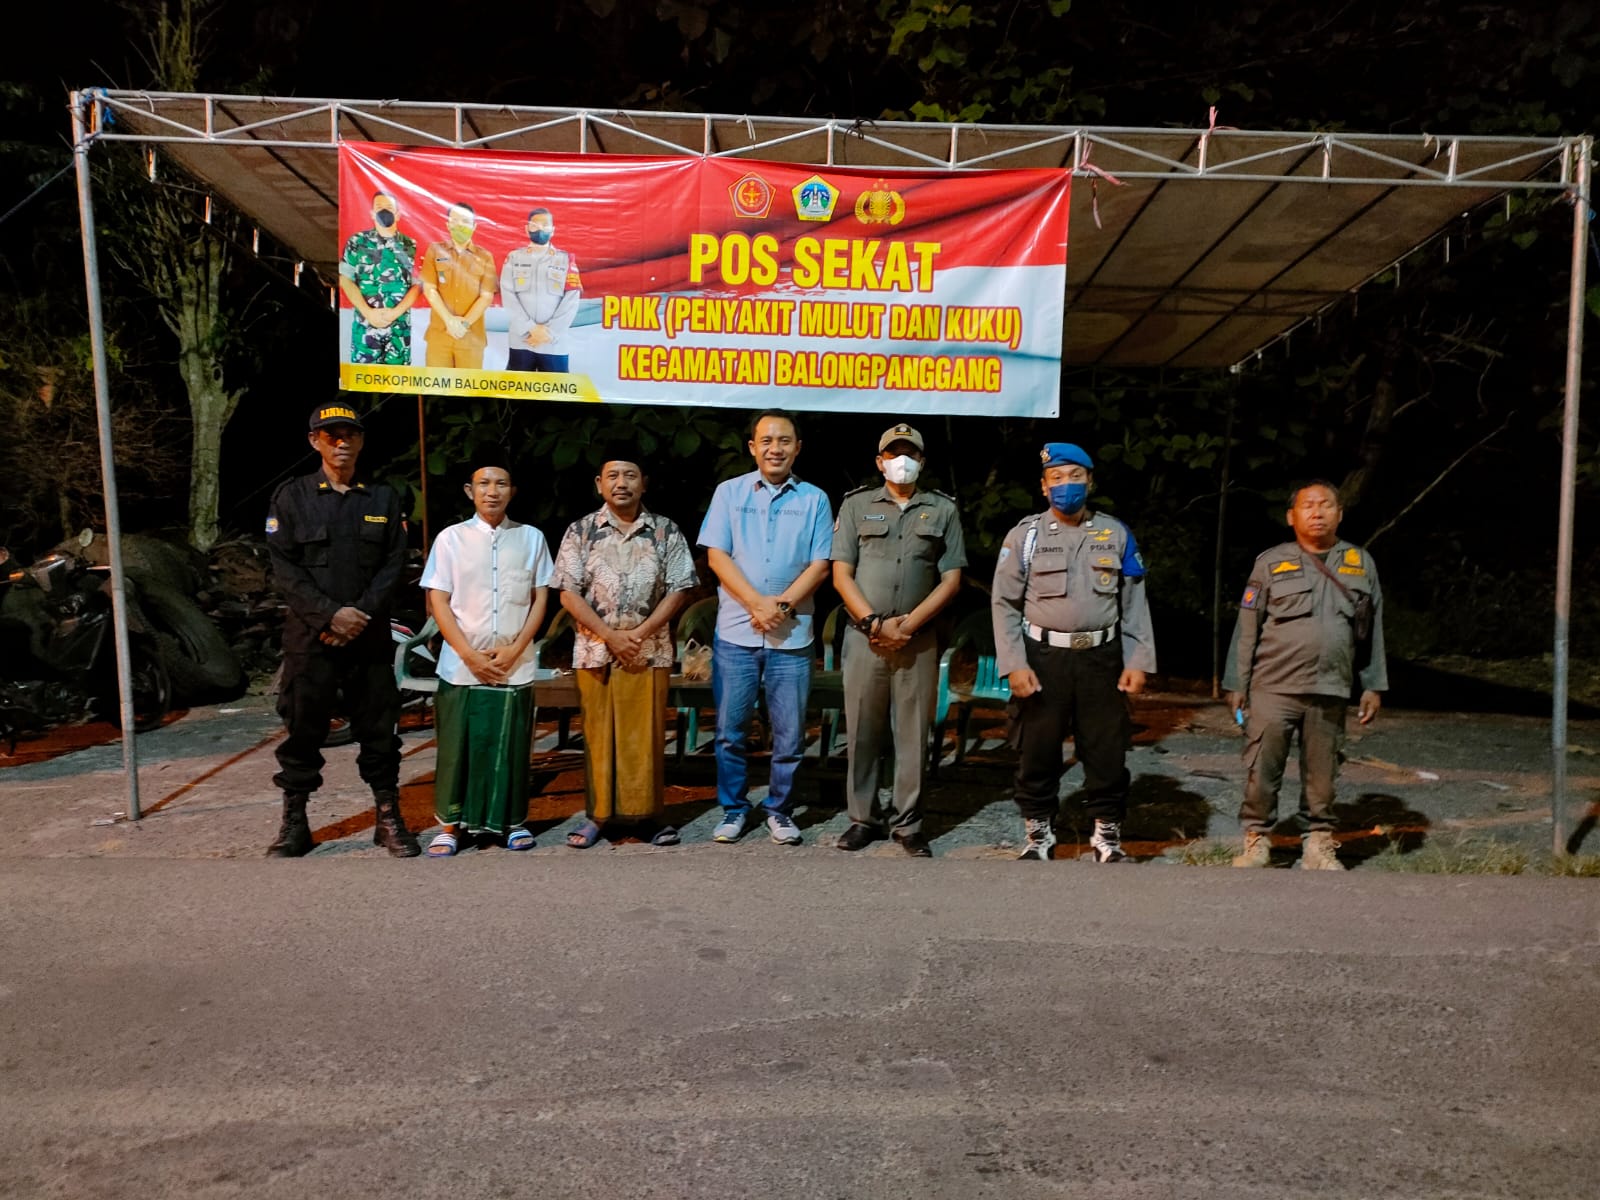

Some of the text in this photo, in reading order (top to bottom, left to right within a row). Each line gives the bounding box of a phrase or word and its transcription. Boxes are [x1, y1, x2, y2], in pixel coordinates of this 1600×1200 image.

[689, 232, 942, 292] POS SEKAT
[603, 295, 1022, 350] PMK (PENYAKIT MULUT DAN KUKU)
[355, 373, 578, 395] FORKOPIMCAM BALONGPANGGANG
[618, 344, 1002, 392] KECAMATAN BALONGPANGGANG
[1089, 543, 1117, 552] POLRI
